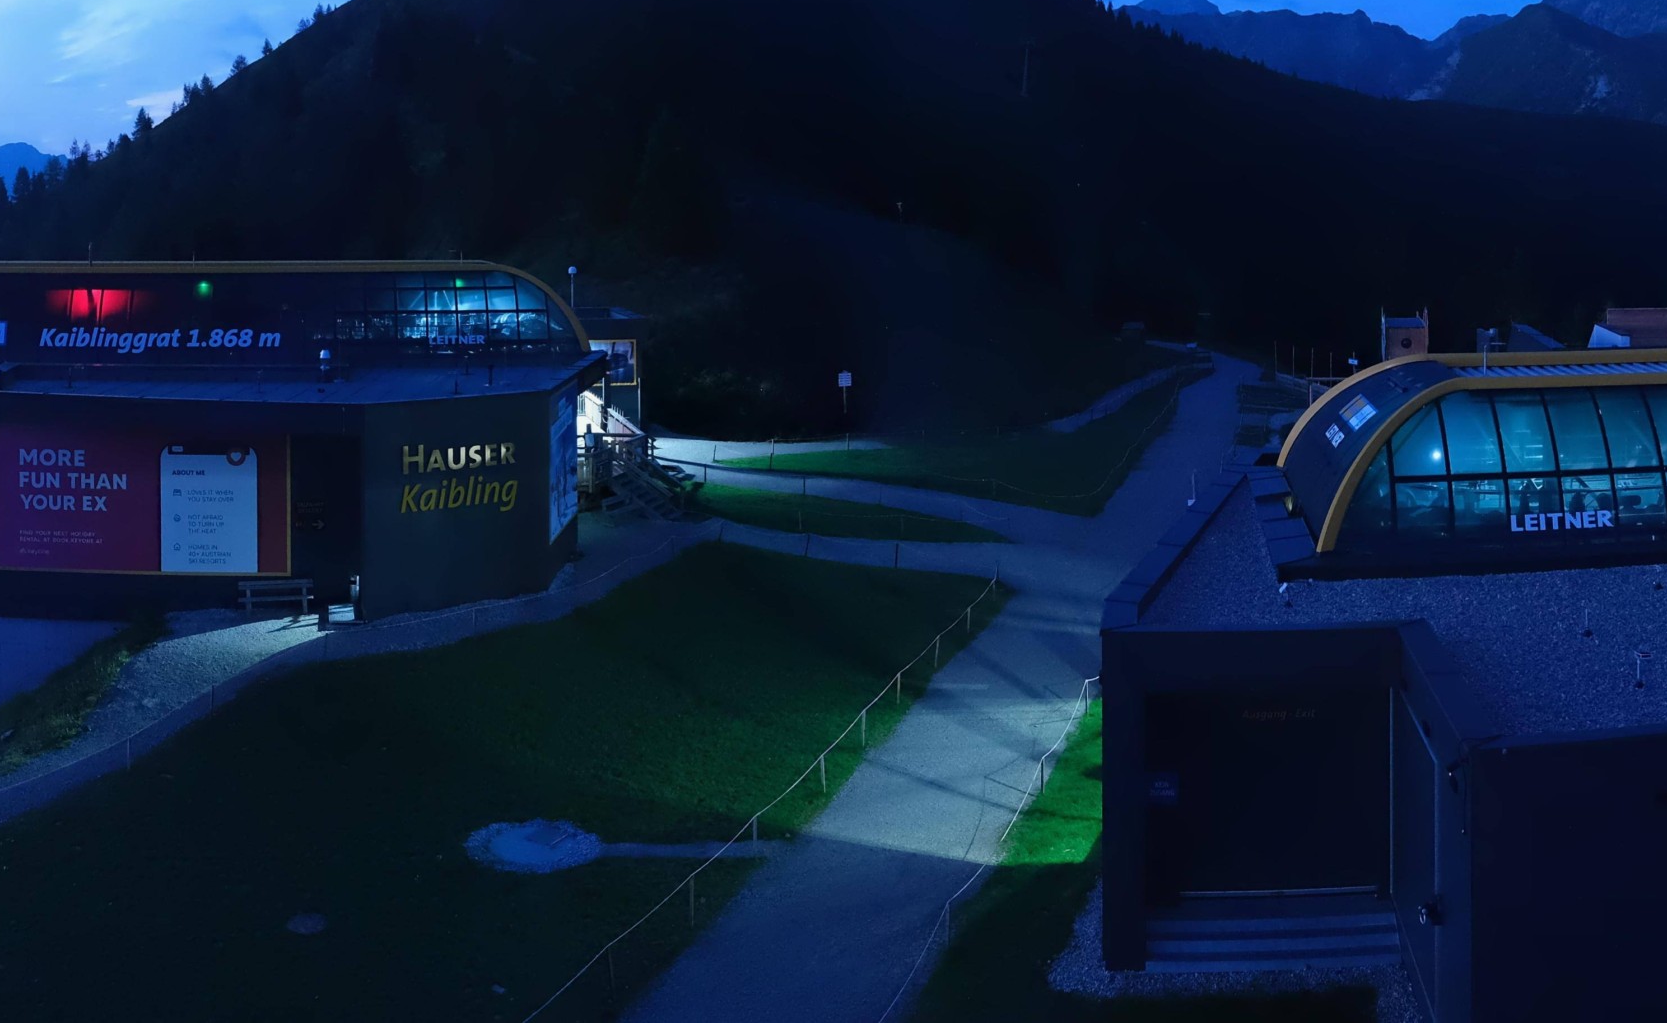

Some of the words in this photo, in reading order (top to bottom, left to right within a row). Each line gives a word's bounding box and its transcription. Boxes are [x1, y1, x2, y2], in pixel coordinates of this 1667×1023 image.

[39, 327, 180, 353] Kaiblinggrat
[186, 329, 252, 347] 1.868
[258, 332, 281, 347] m
[428, 335, 486, 345] LEITNER
[19, 449, 86, 467] MORE
[402, 442, 516, 475] HAUSER
[19, 471, 60, 489] FUN
[67, 473, 127, 490] THAN
[20, 494, 76, 511] YOUR
[82, 495, 108, 512] EX
[401, 475, 518, 514] Kaibling
[1510, 510, 1614, 532] LEITNER
